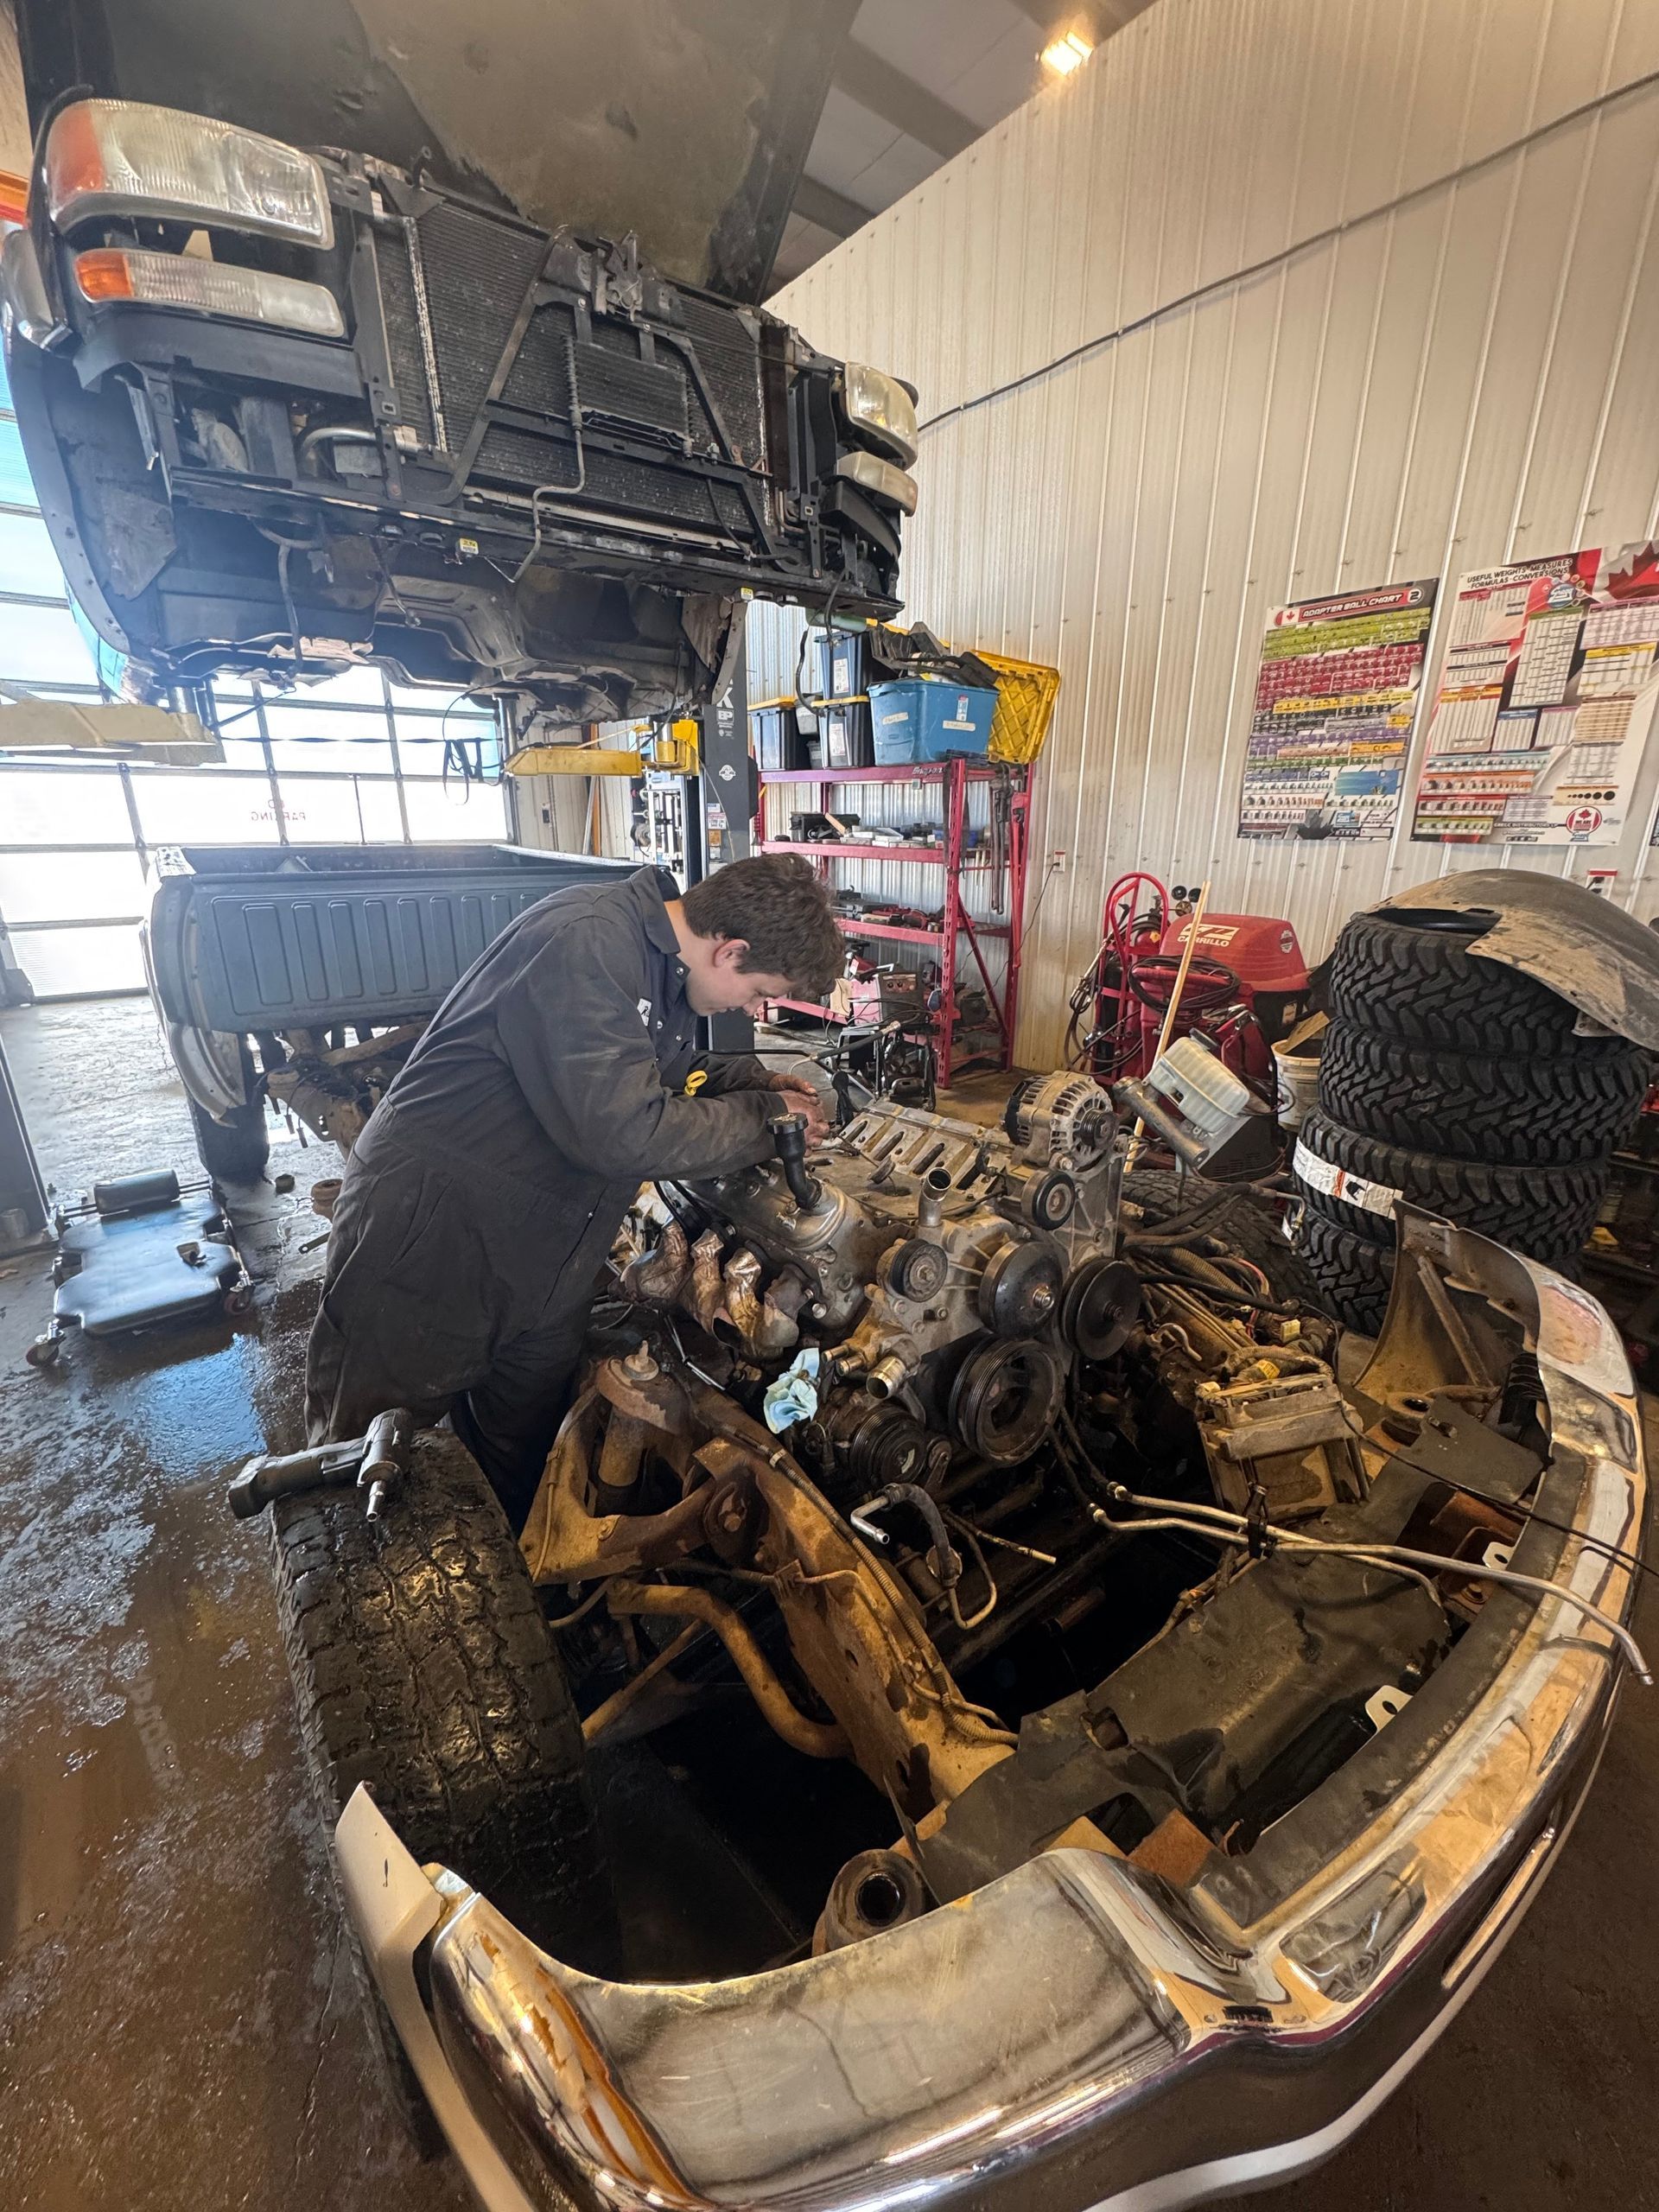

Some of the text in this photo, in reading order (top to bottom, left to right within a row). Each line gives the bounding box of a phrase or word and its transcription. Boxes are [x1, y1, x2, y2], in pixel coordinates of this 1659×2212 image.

[1467, 558, 1573, 583] USEFUL WEIGHTS MEASURES
[1471, 567, 1569, 589] FORMULAS CONVERSIONS
[1302, 590, 1421, 618] ADAPTER BALL CHART 2
